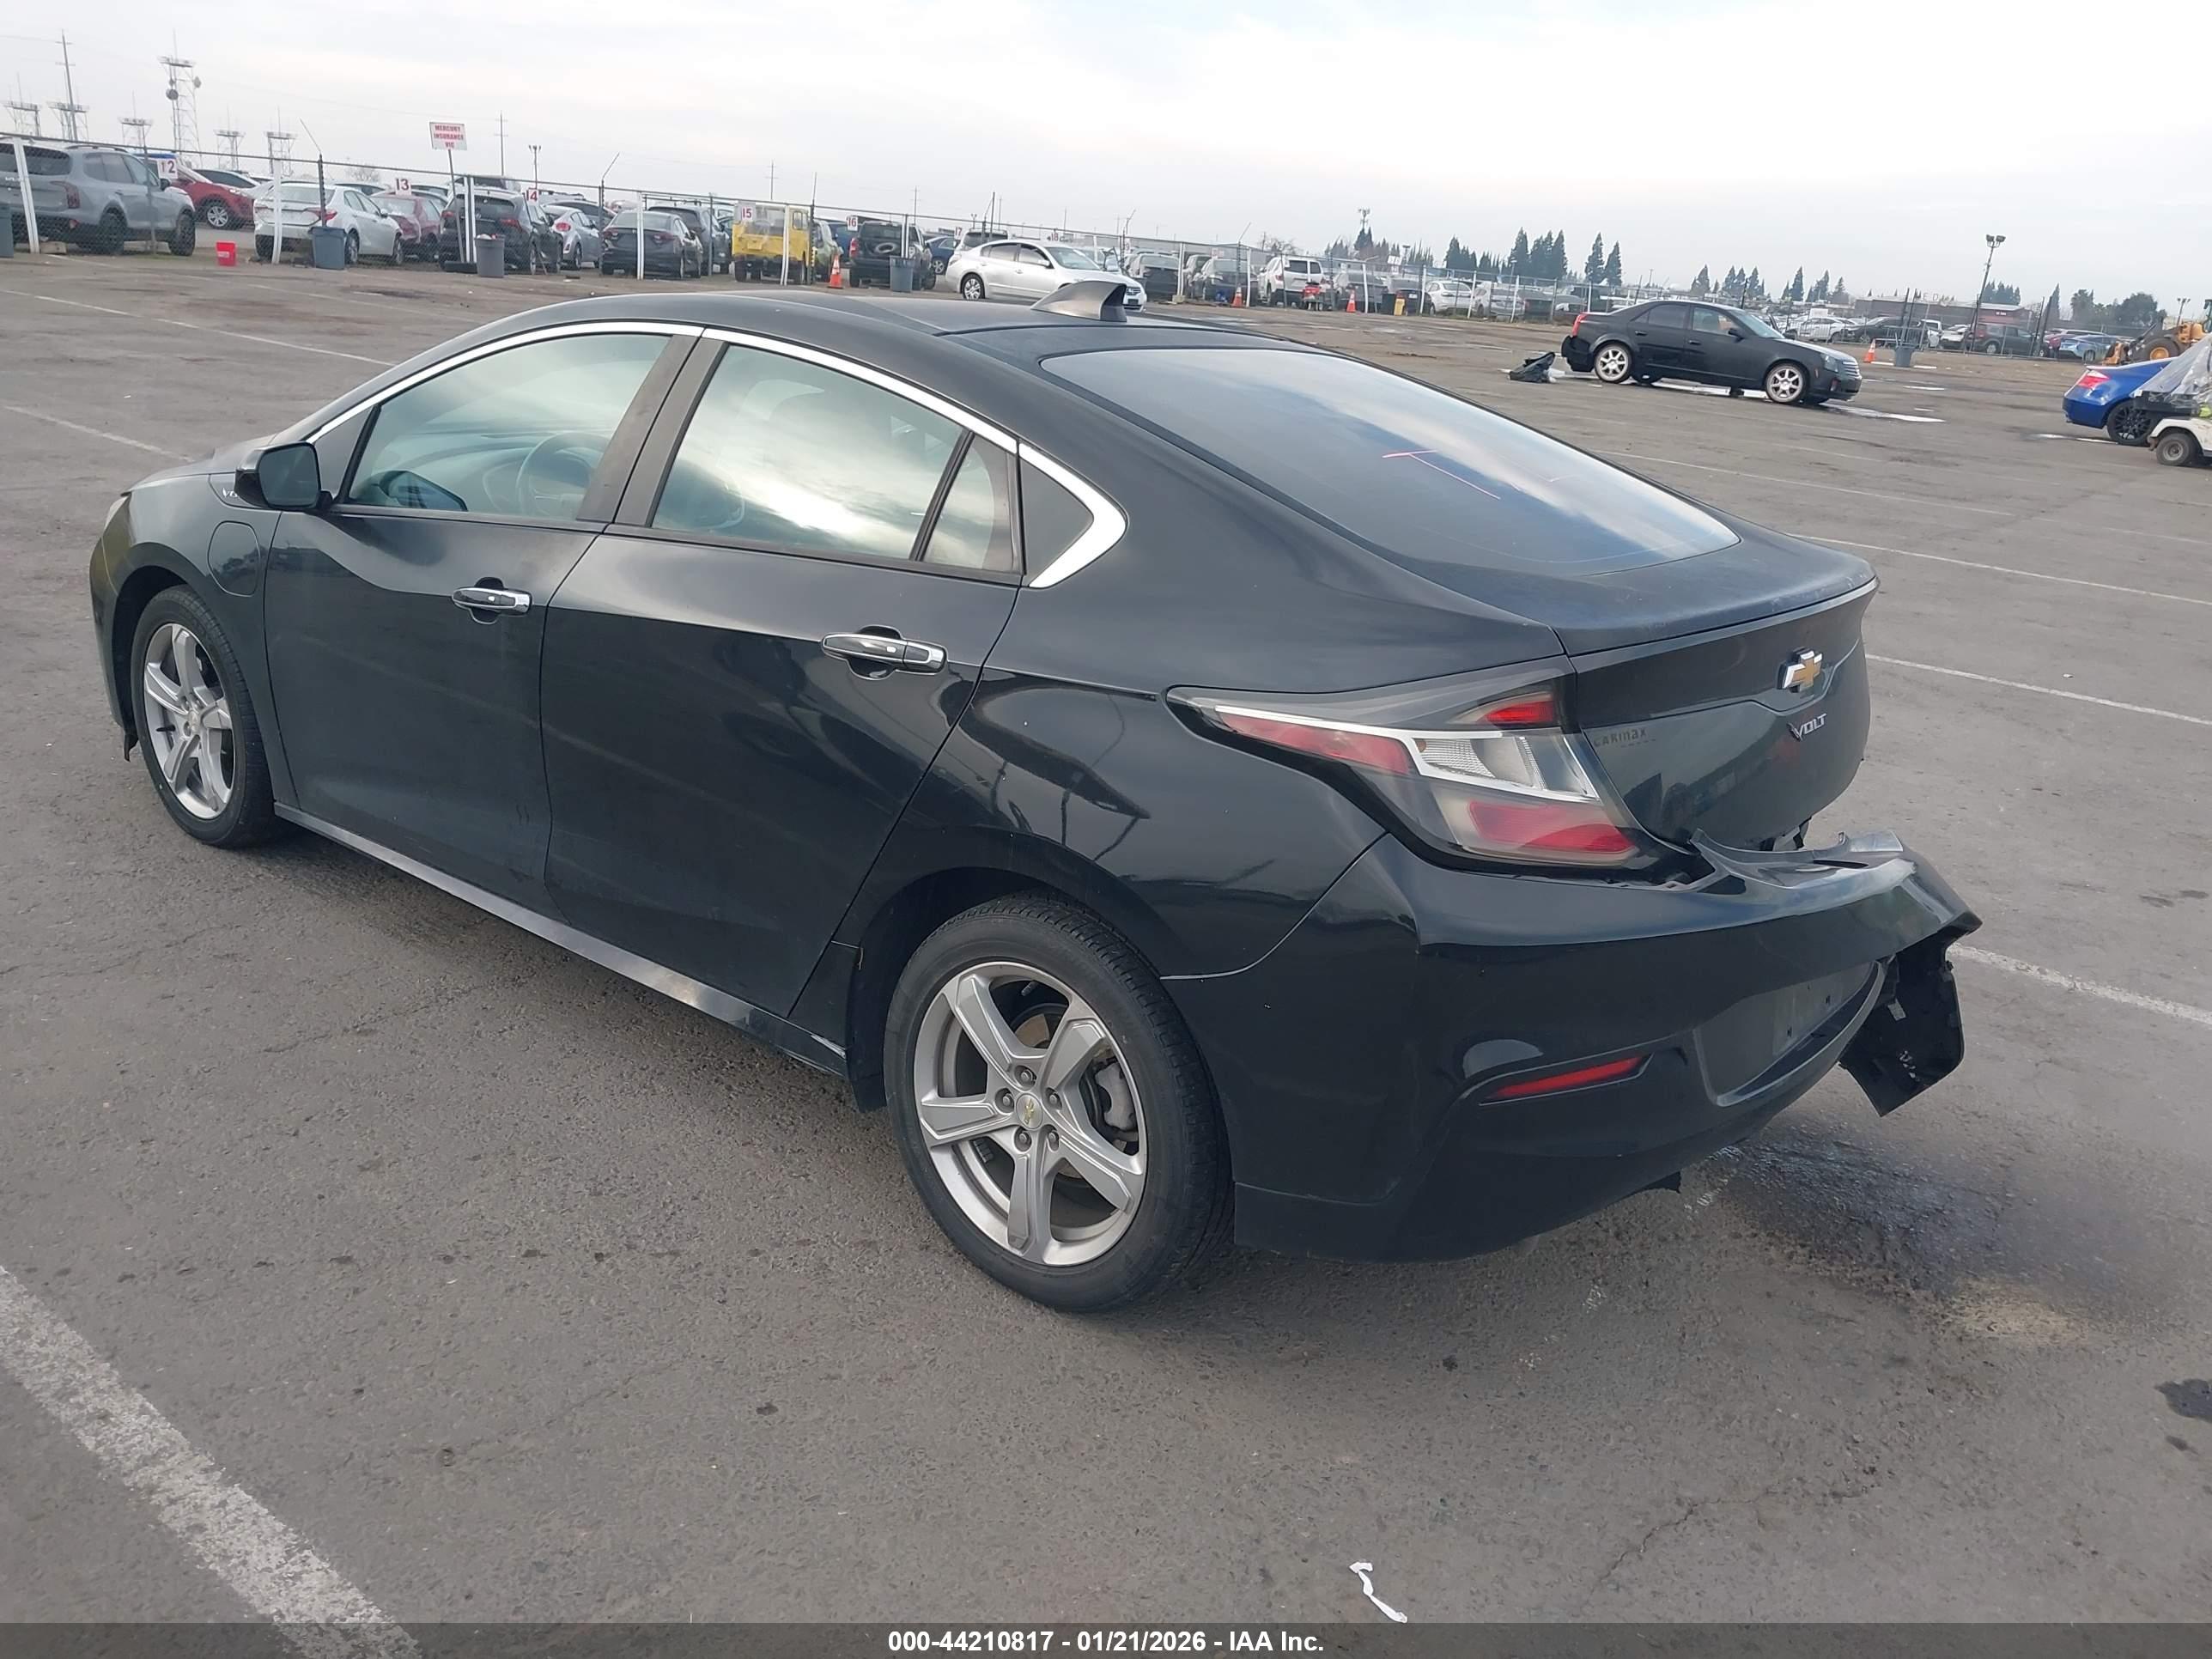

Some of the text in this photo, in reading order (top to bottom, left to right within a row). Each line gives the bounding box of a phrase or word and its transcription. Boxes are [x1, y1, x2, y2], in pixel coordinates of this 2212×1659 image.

[161, 160, 176, 173] 12
[396, 178, 410, 191] 13
[526, 190, 538, 202] 14
[742, 208, 752, 219] 15
[955, 226, 963, 236] 17
[1051, 233, 1059, 241] 18
[1787, 713, 1827, 742] VOLT
